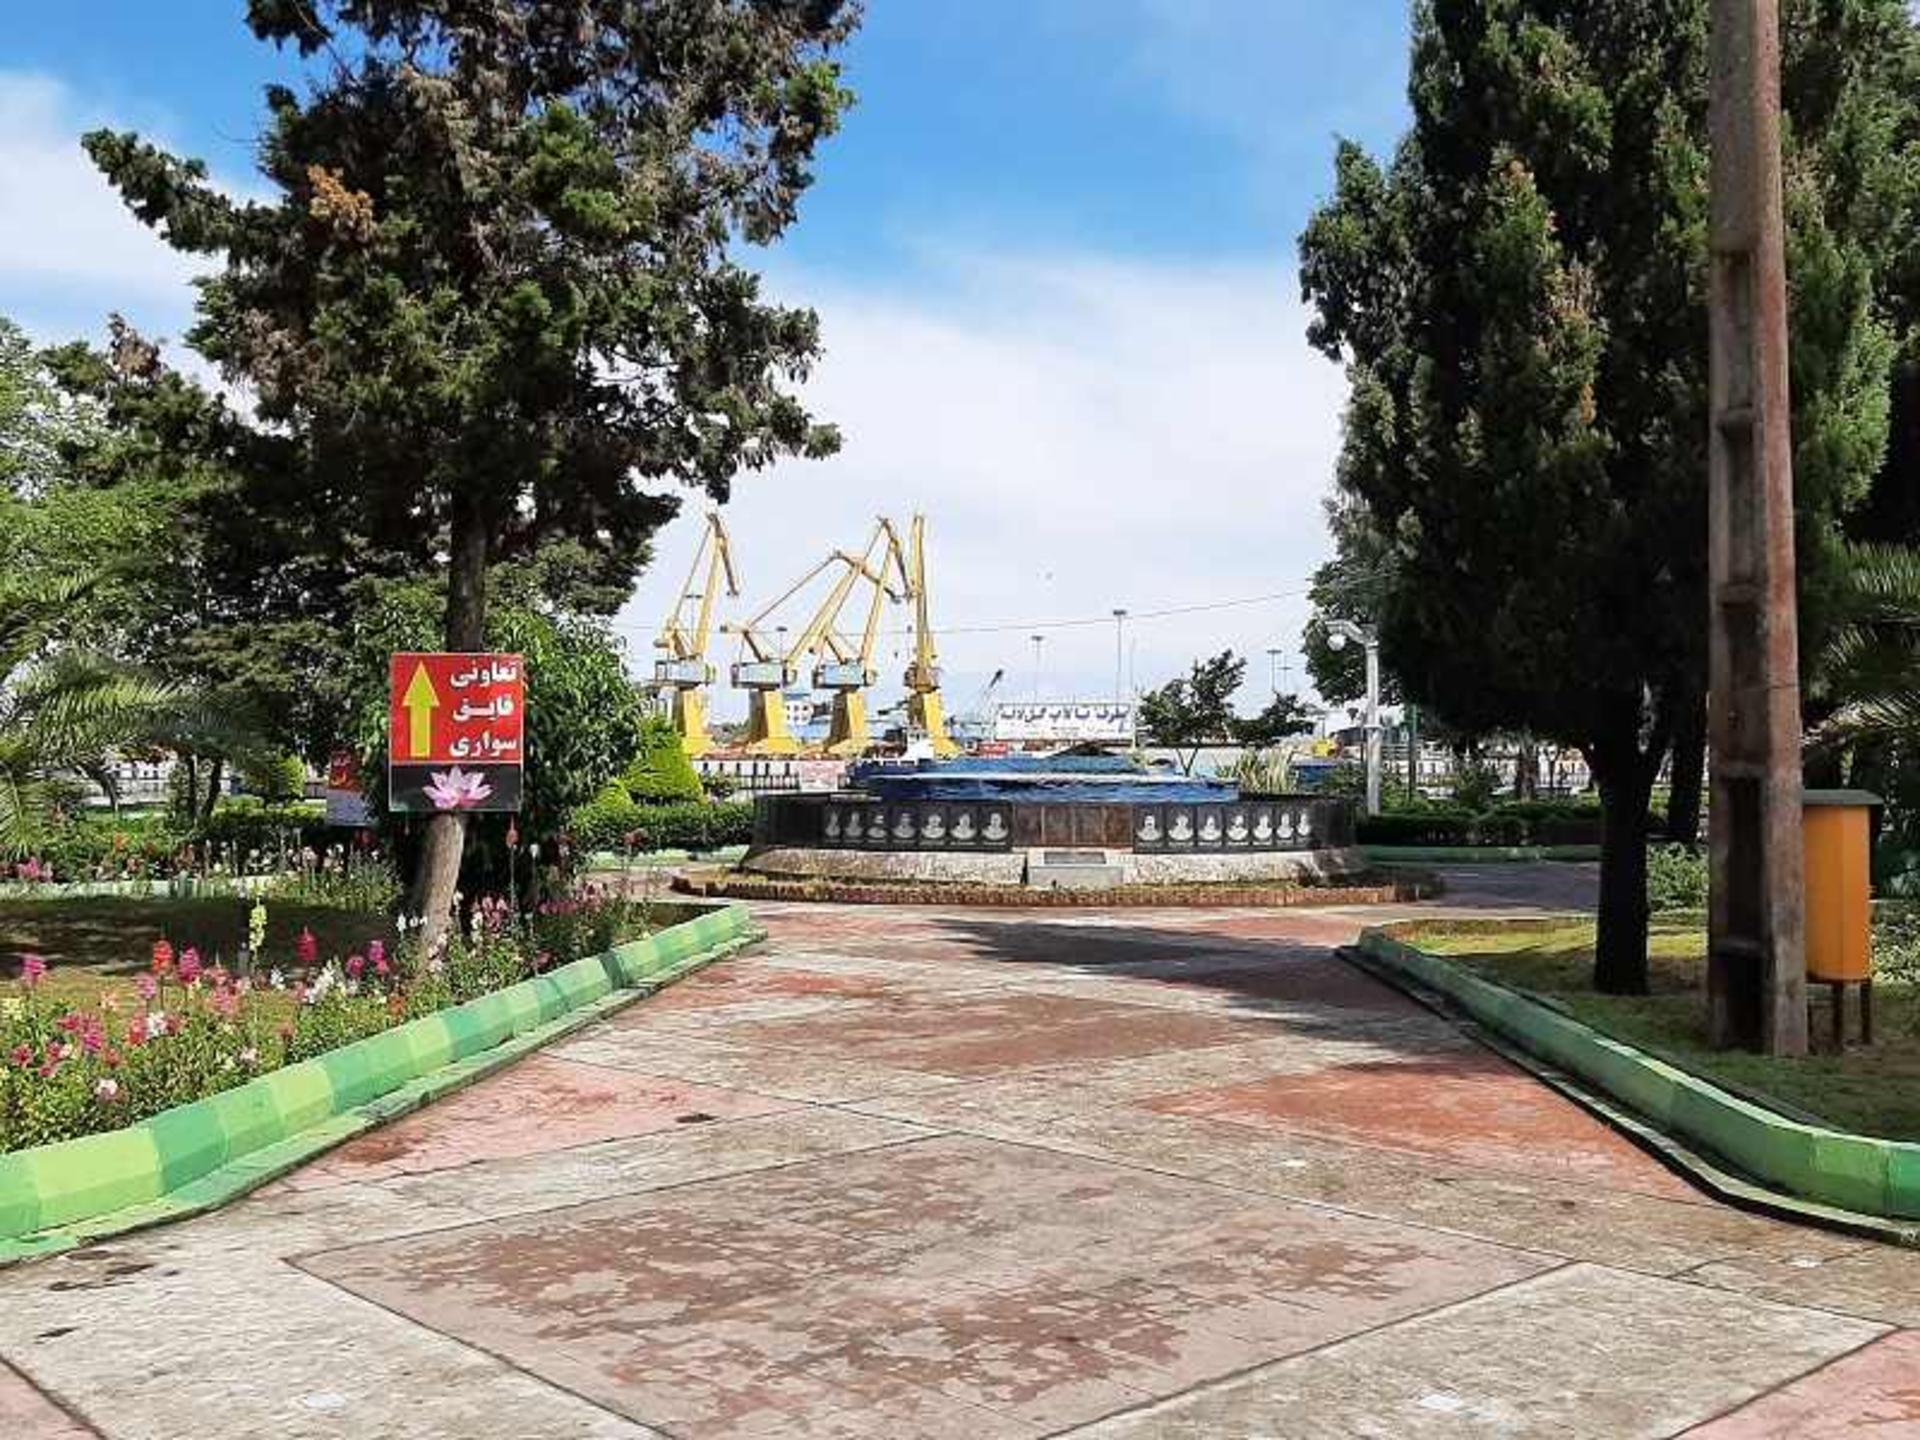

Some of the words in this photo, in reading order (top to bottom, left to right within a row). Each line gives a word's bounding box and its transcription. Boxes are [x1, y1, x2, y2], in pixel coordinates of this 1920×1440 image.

[450, 659, 517, 687] تعاونی
[452, 693, 515, 721] قایق
[449, 730, 517, 757] سواری
